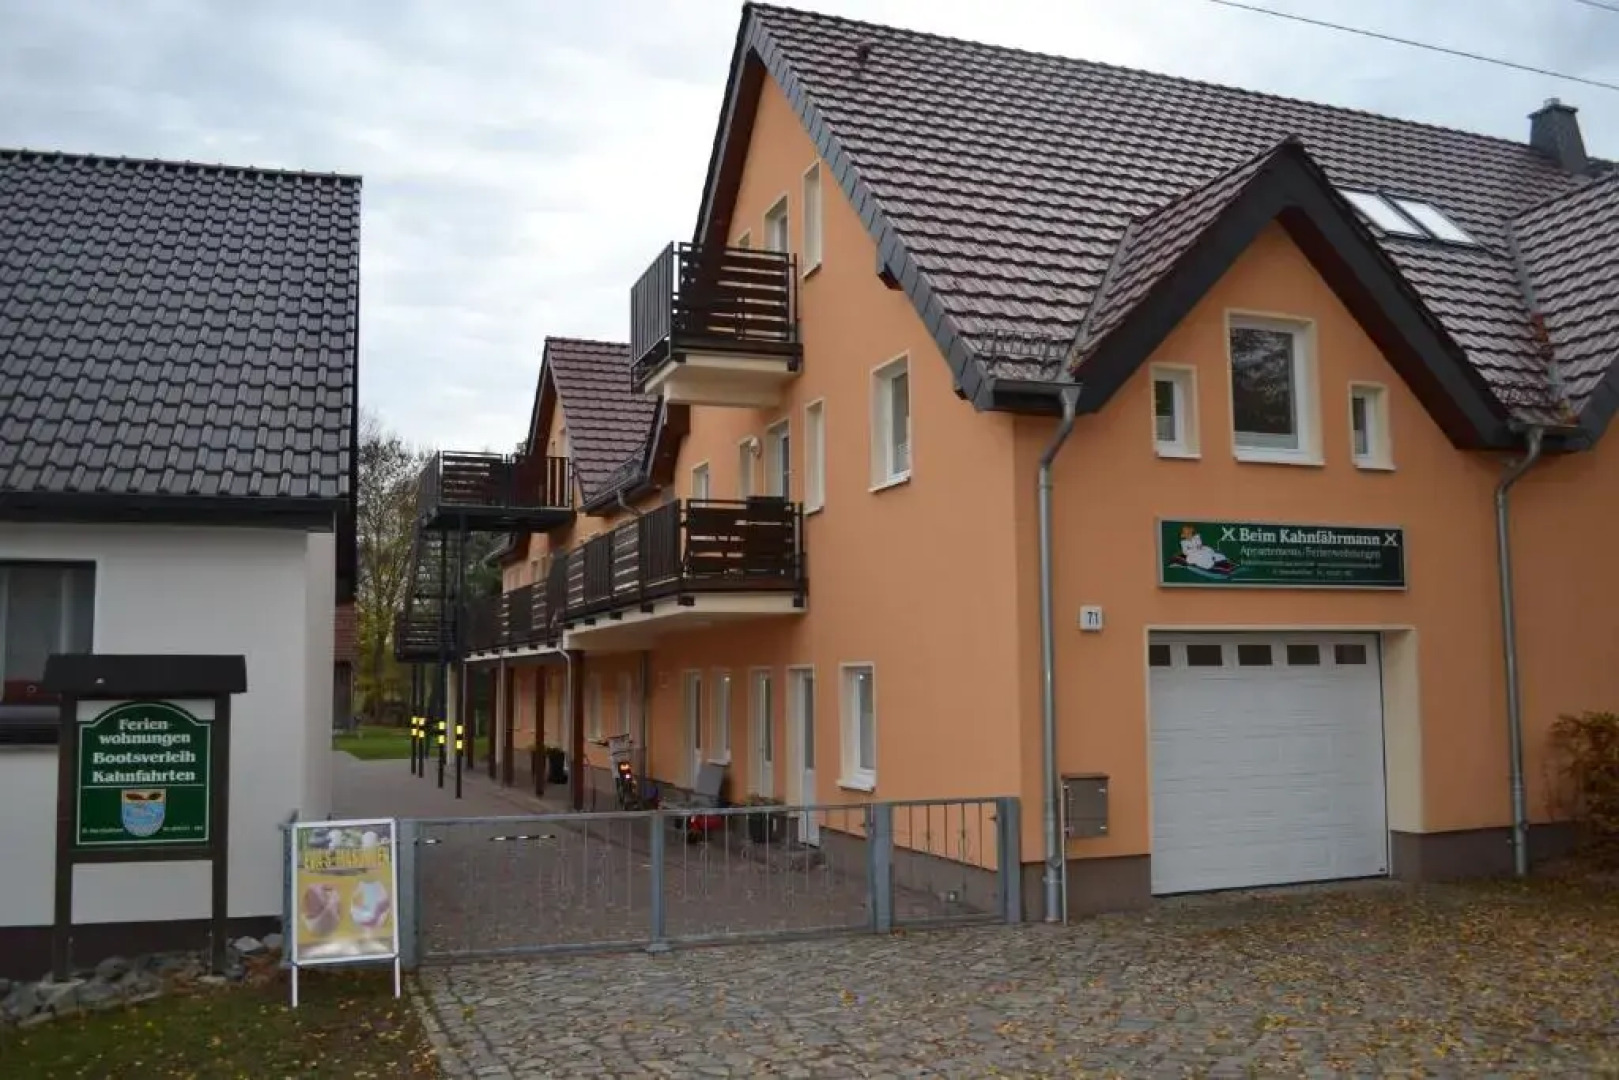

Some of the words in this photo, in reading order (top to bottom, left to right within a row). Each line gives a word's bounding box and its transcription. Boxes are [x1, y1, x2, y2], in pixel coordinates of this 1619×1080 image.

[1240, 528, 1276, 542] Beim
[1279, 528, 1380, 545] Kahnfährmann
[1087, 611, 1099, 626] 71
[99, 733, 191, 747] wohnungen
[92, 751, 196, 764] Bootsverleih
[92, 769, 196, 783] Kahnfahrten
